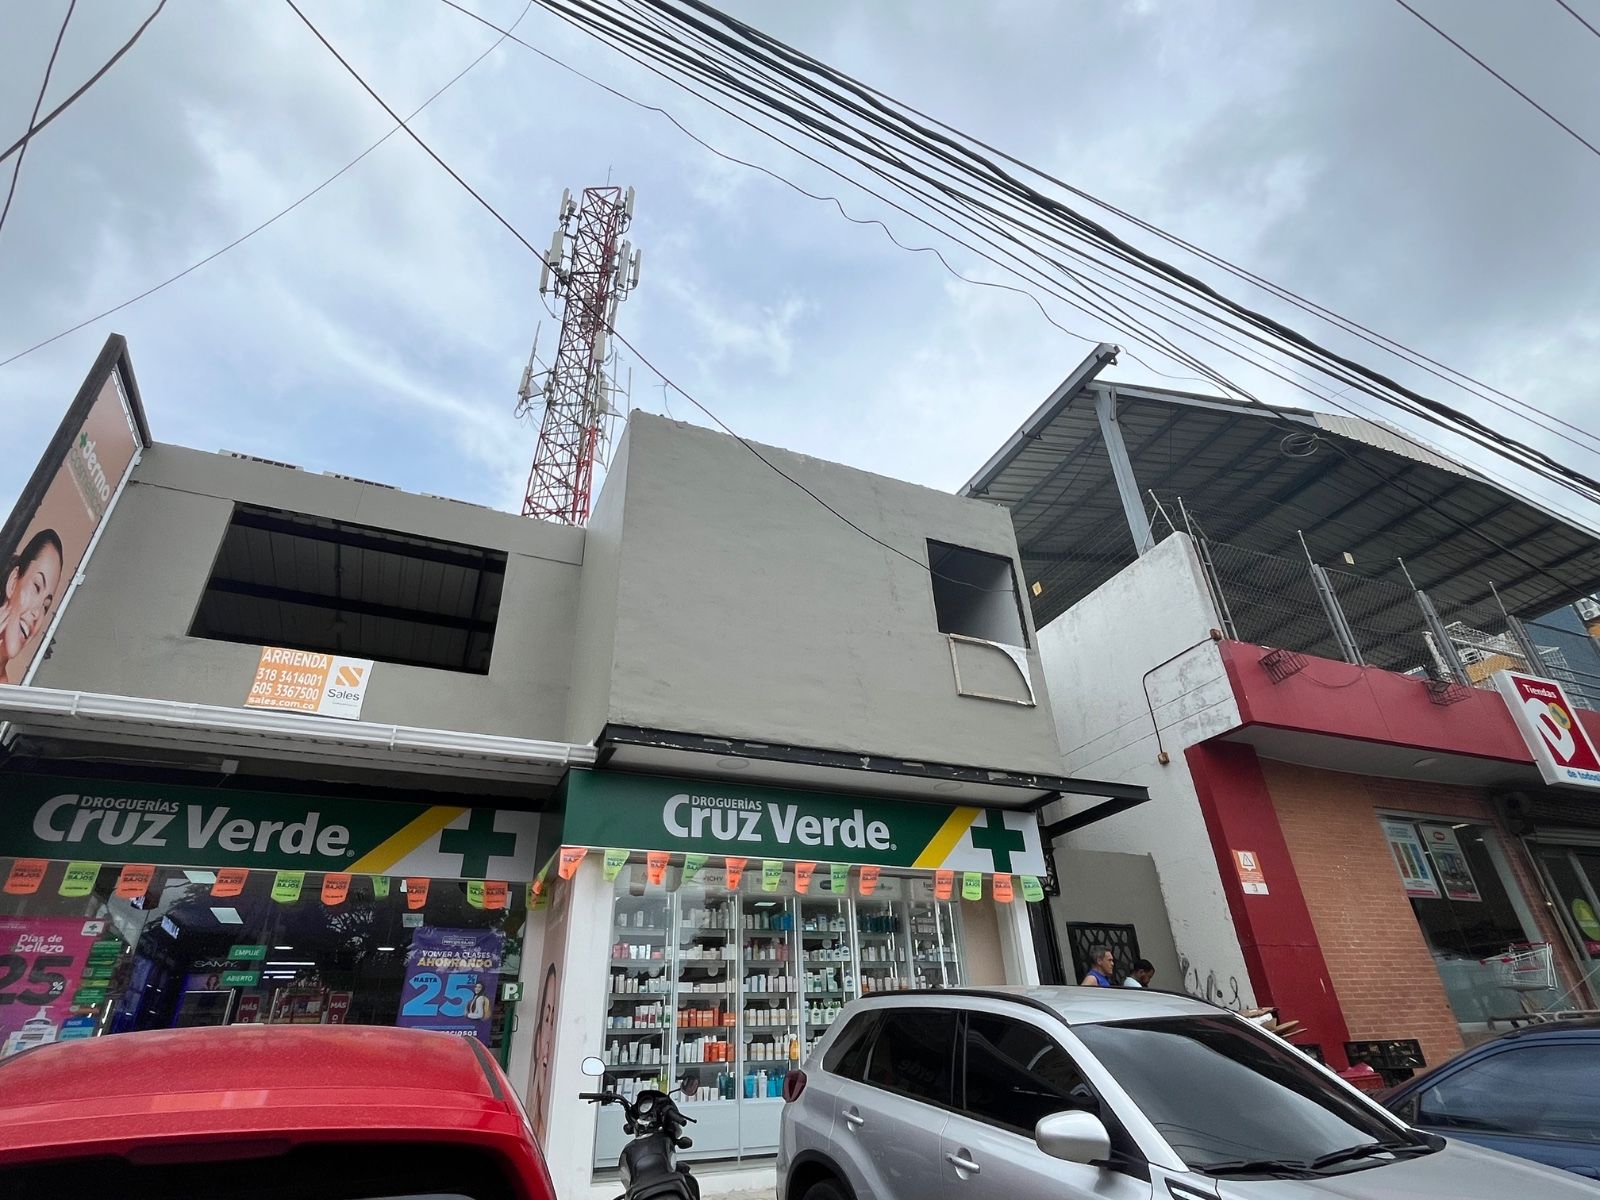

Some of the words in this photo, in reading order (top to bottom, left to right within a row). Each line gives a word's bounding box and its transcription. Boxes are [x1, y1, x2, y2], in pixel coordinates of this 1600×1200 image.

[261, 648, 328, 670] ARRIENDA
[256, 668, 278, 681] 318
[279, 670, 323, 687] 3414001
[252, 681, 273, 694] 605
[274, 684, 319, 701] 3367500
[327, 688, 360, 701] Sales
[1522, 683, 1557, 699] Tiendas
[248, 696, 315, 710] sales.com.co
[1567, 769, 1578, 778] de
[80, 795, 180, 813] DROGUERÍAS
[691, 795, 762, 810] DROGUERÍAS
[33, 794, 176, 847] Cruz
[187, 804, 350, 857] Verde
[663, 793, 762, 842] Cruz
[767, 803, 890, 850] Verde
[20, 934, 45, 943] Días
[48, 934, 63, 943] de
[15, 942, 65, 954] belleza
[422, 950, 454, 959] VOLVER
[462, 951, 492, 959] CLASES
[417, 957, 493, 968] AHORRANDO
